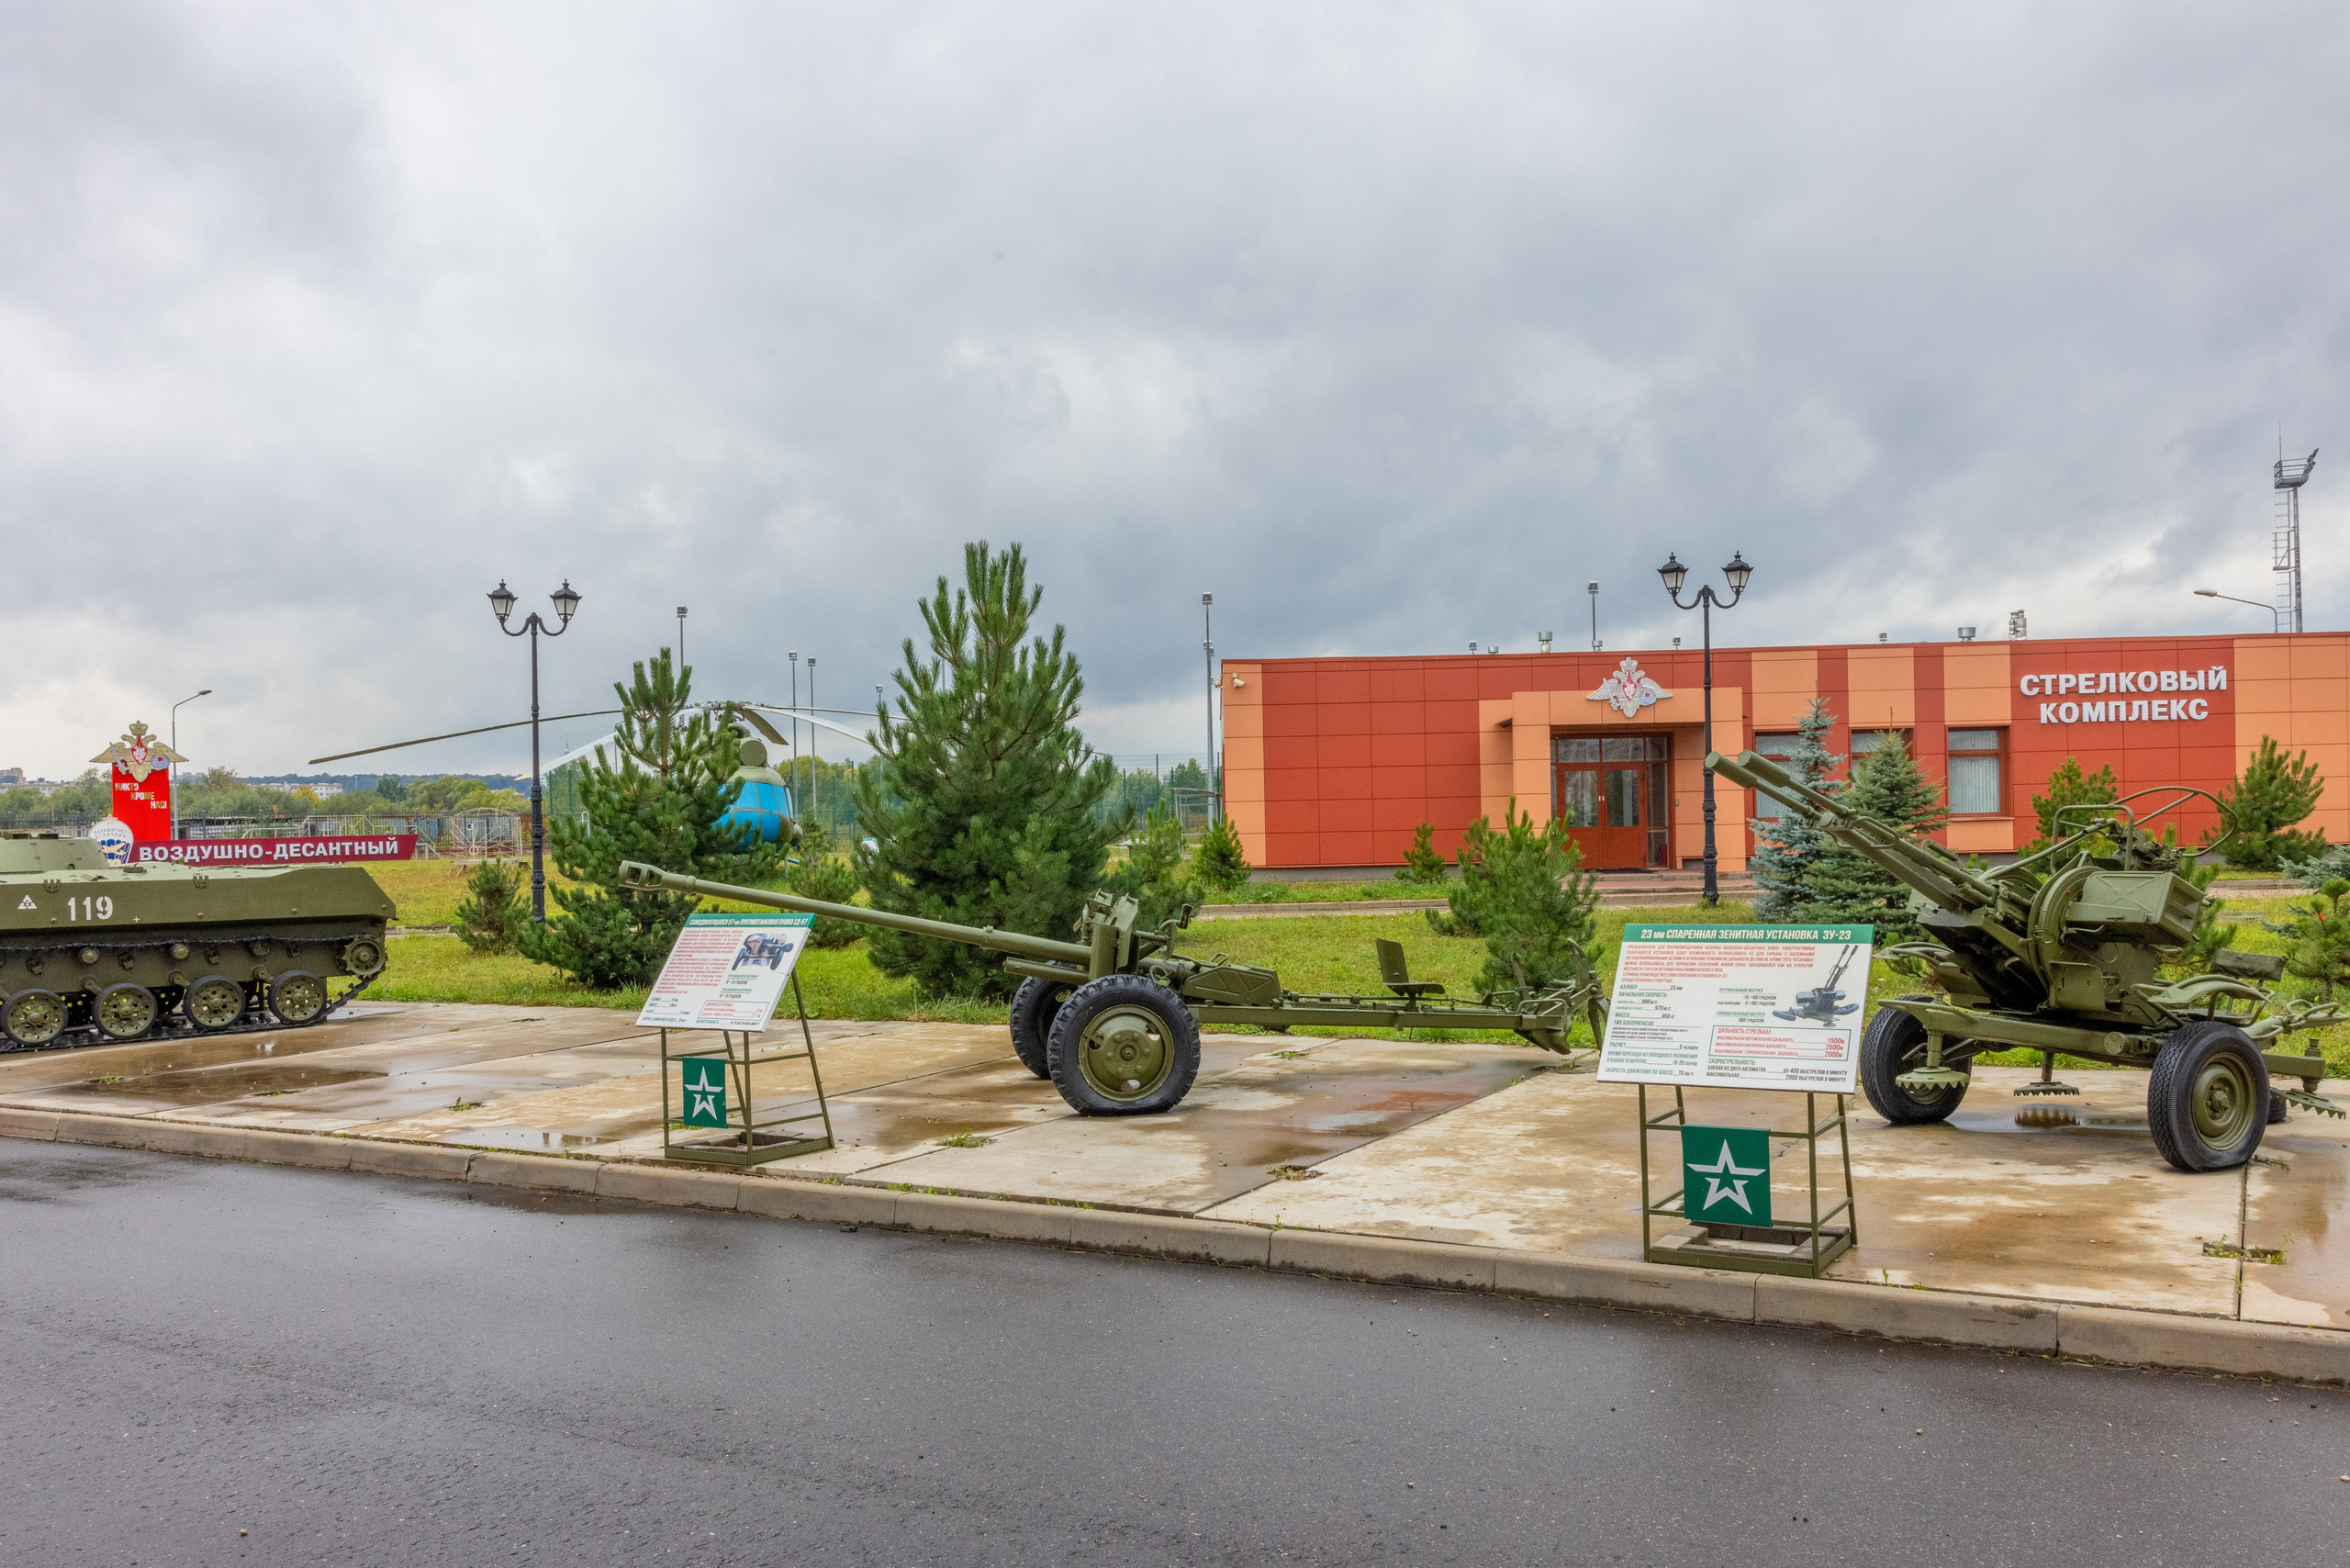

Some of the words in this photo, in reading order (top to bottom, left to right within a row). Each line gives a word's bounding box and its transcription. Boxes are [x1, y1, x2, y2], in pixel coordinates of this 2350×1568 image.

[2020, 666, 2227, 696] СТРЕЛКОВЫЙ
[2040, 699, 2209, 724] КОМПЛЕКС
[116, 783, 139, 791] НИКТО
[131, 792, 154, 801] КРОМЕ
[140, 836, 399, 863] ВОЗДУШНО-ДЕСАНТНЫЙ
[68, 896, 113, 921] 119
[1666, 930, 1717, 939] СПАРЕННАЯ
[1718, 930, 1763, 939] ЗЕНИТНАЯ
[1766, 930, 1818, 940] УСТАНОВКА
[1823, 930, 1852, 940] ЗУ-23
